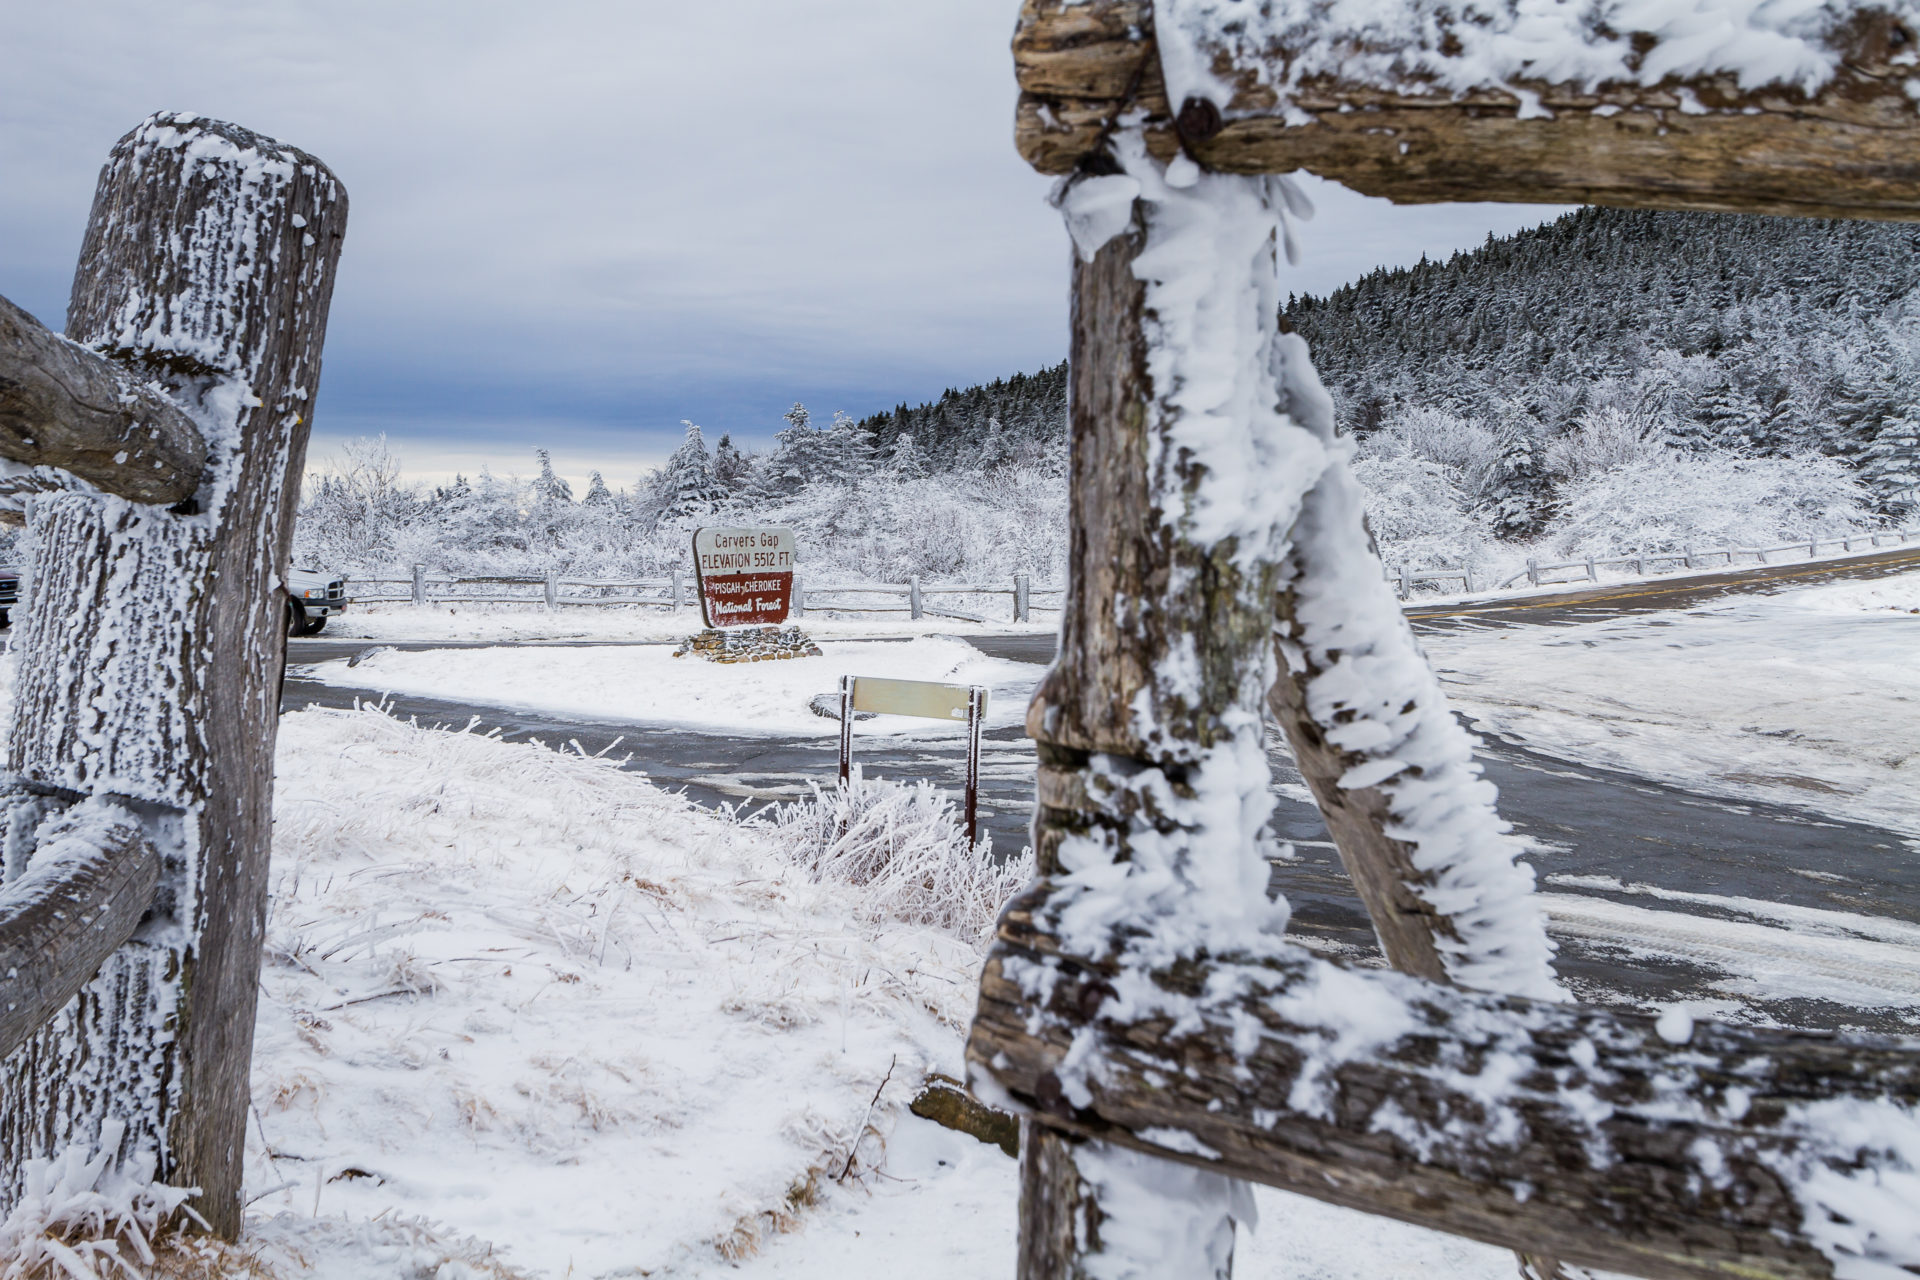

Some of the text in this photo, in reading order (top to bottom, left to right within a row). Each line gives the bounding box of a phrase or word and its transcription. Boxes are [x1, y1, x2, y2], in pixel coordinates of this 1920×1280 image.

[715, 532, 779, 549] Carvers Gap
[702, 551, 792, 569] ELEVATION 5512 FT.
[715, 597, 782, 615] National Forest
